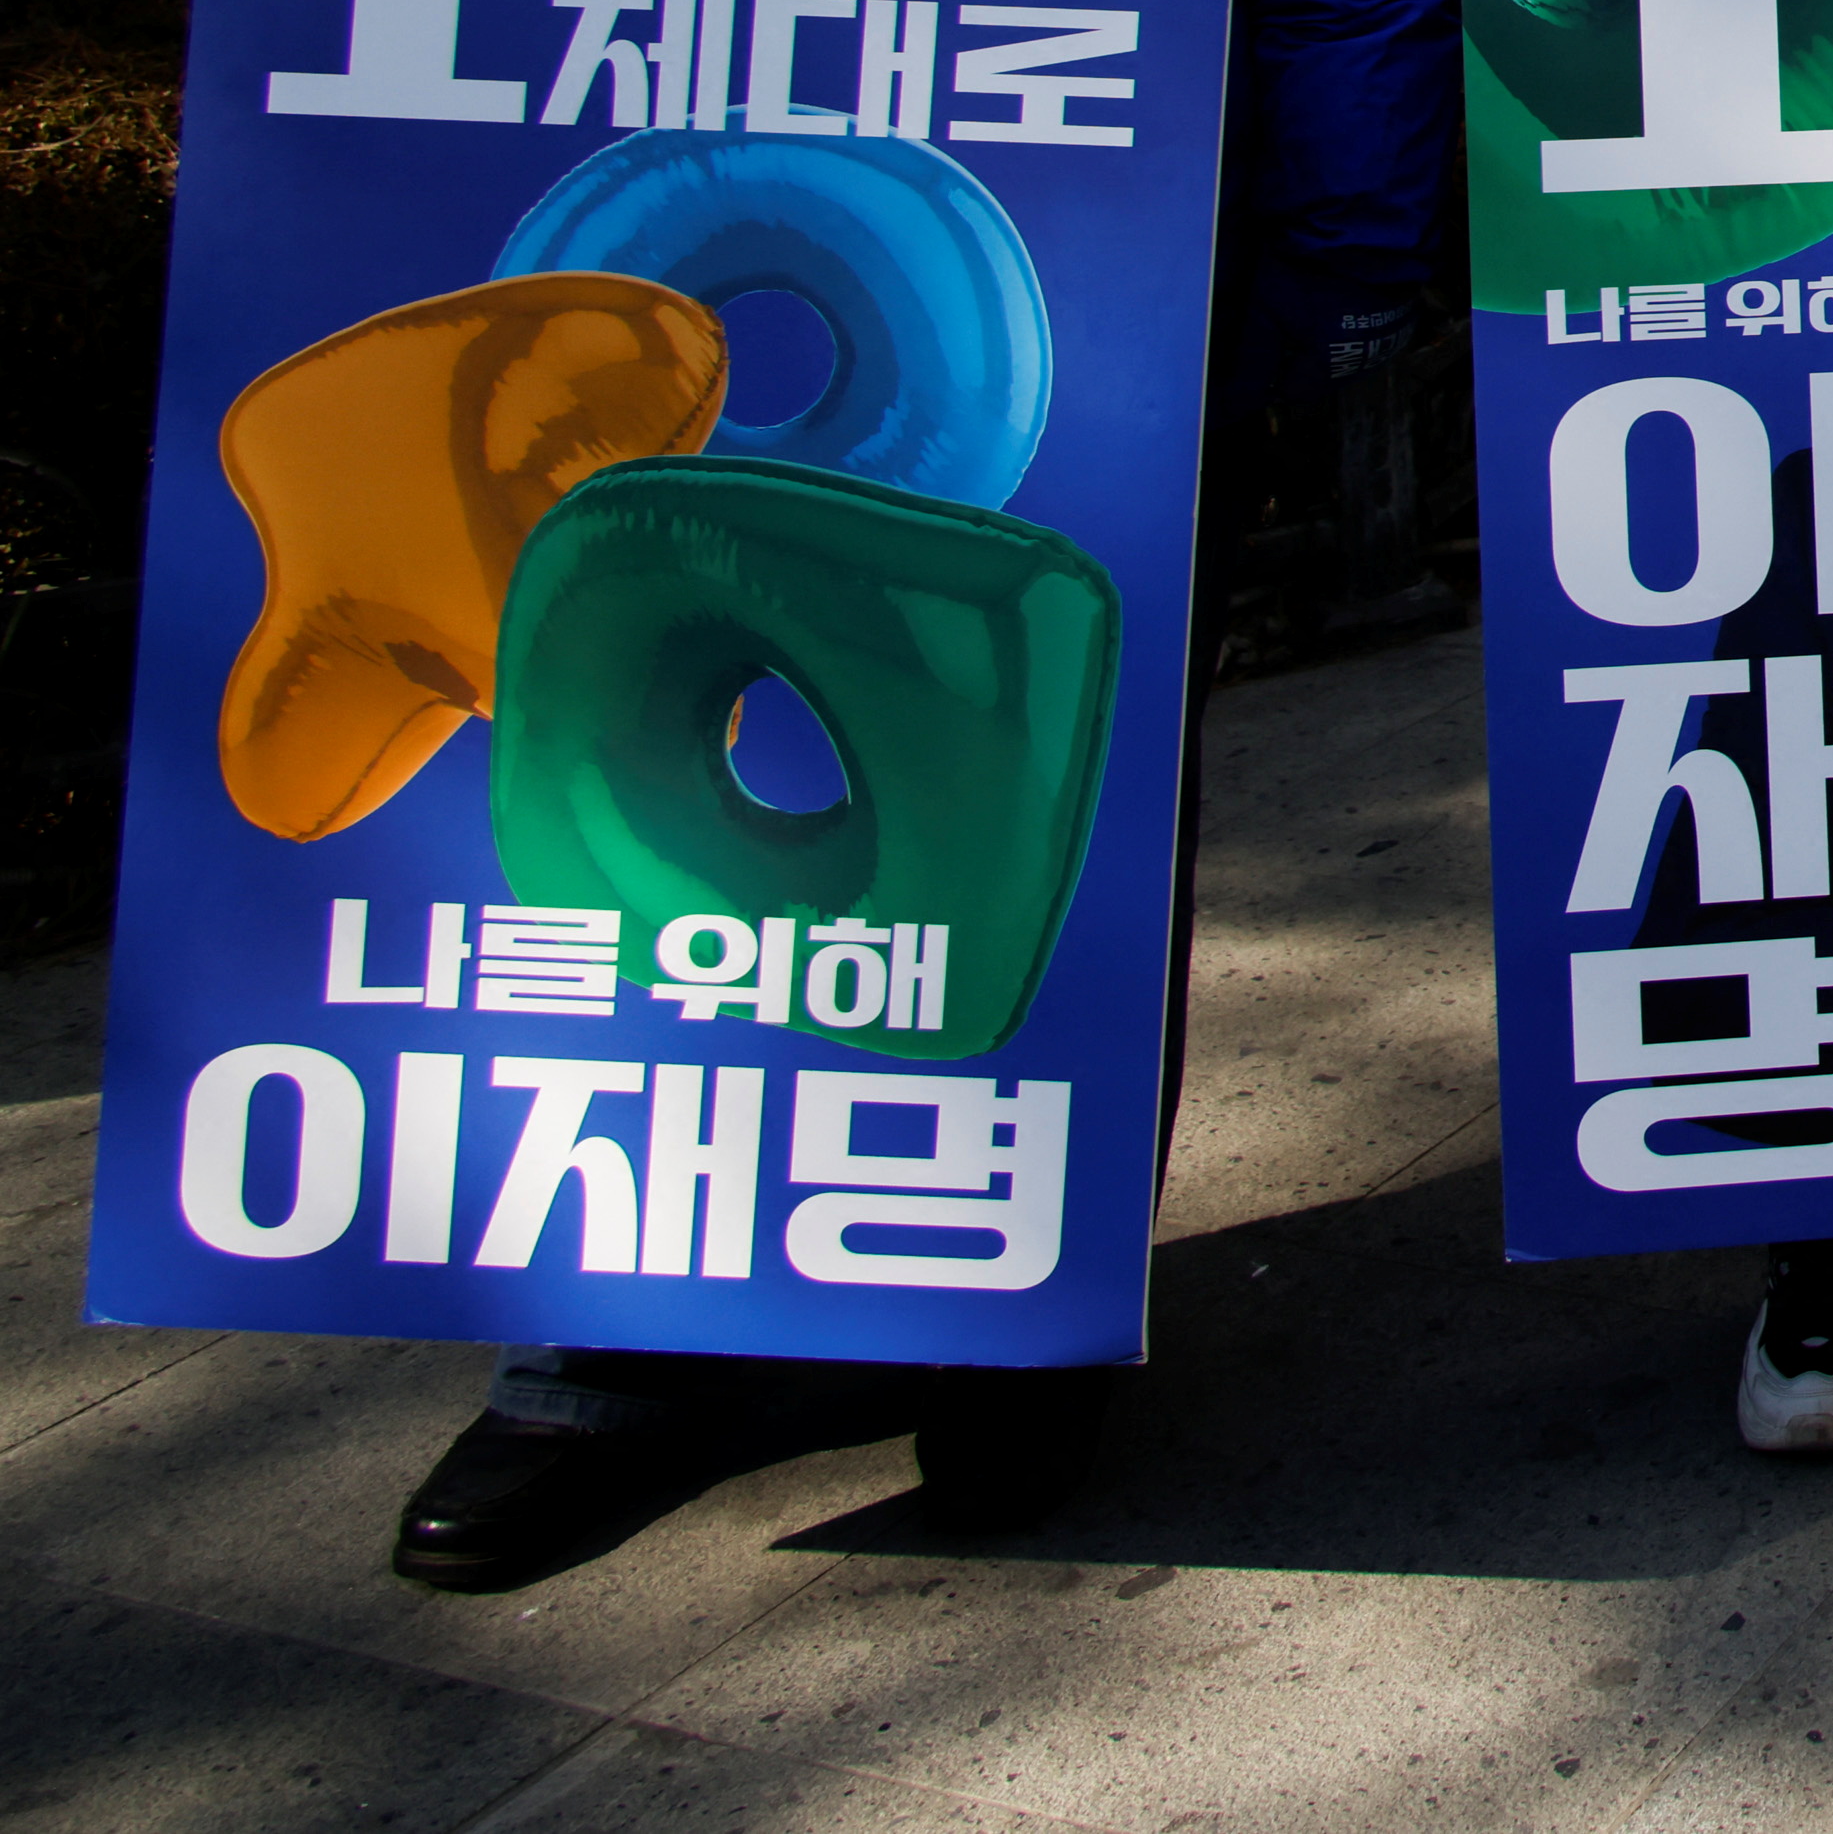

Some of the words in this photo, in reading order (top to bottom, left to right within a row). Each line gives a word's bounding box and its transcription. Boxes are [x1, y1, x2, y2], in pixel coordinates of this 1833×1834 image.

[1545, 283, 1707, 345] 나를
[326, 898, 621, 1017] 나를
[648, 913, 949, 1030] 위해
[180, 1043, 1071, 1290] 이재명
